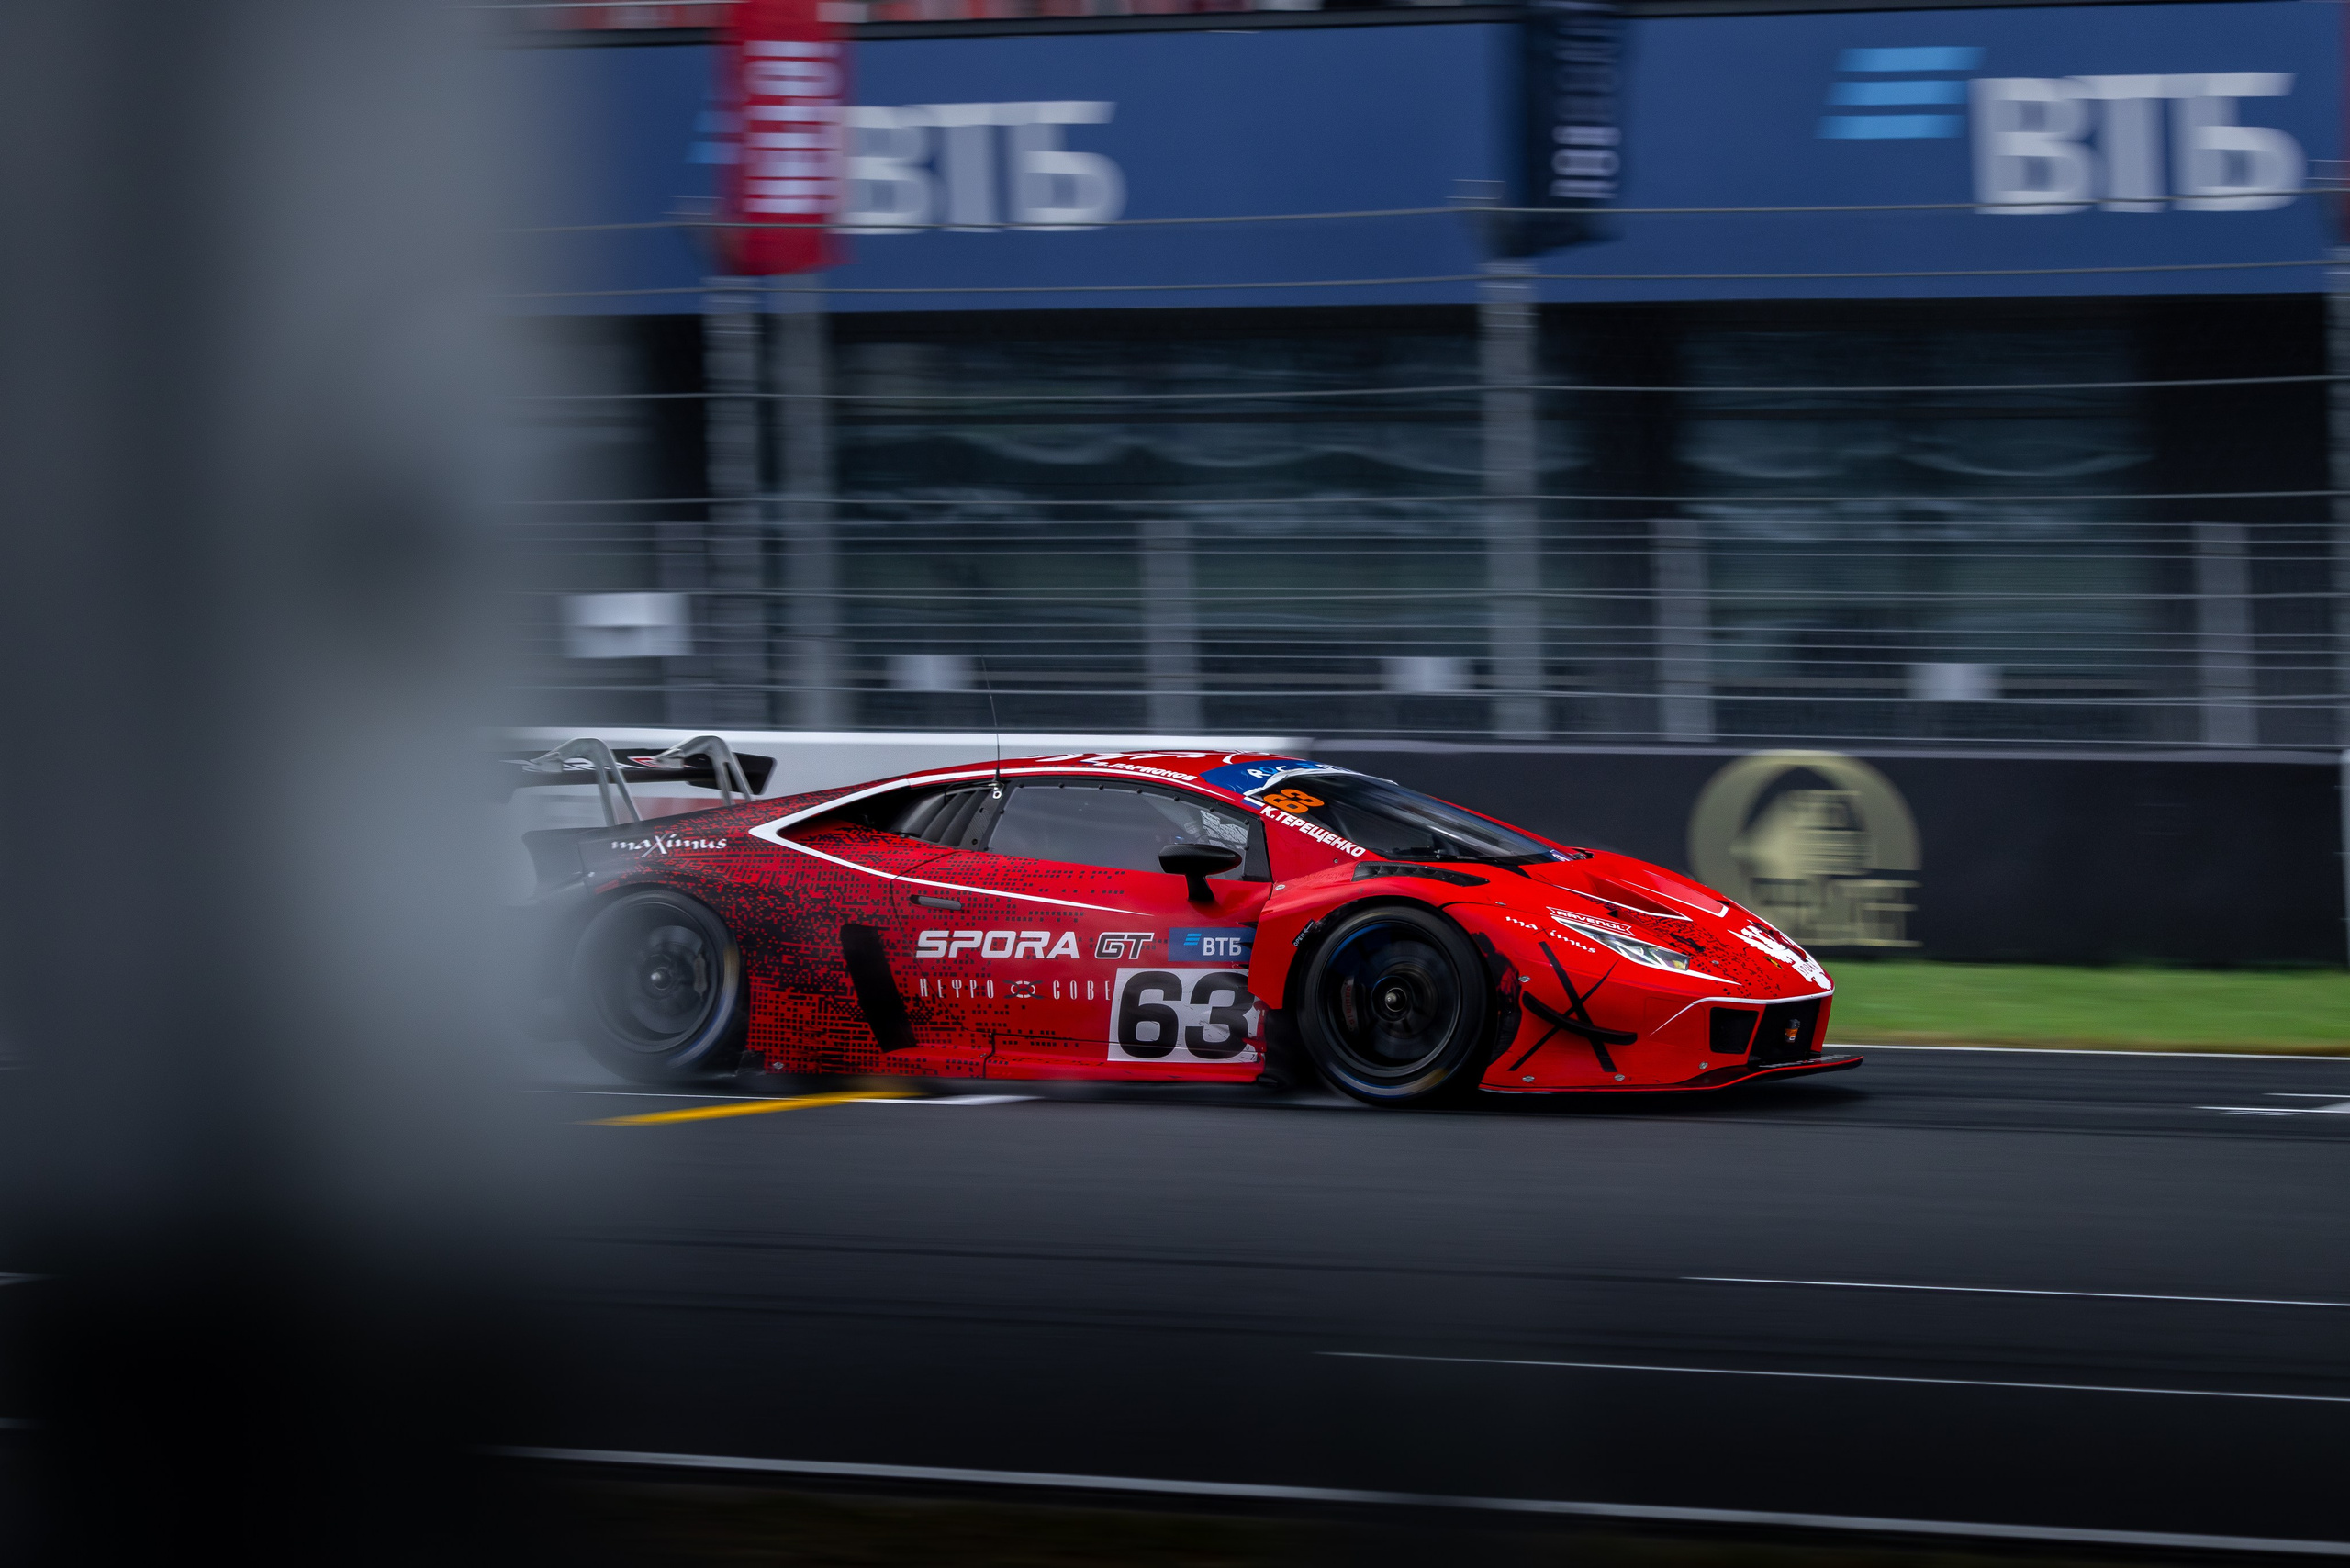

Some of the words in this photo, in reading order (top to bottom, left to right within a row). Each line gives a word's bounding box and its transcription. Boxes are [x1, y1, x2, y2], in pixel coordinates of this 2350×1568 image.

[1968, 72, 2310, 215] ВТБ
[820, 100, 1127, 235] ВТБ
[1263, 789, 1325, 814] 63
[1259, 805, 1366, 857] К.ТЕРЕЩЕНКО
[1556, 910, 1626, 932] RAVENOL
[916, 930, 1080, 959] SPORA
[1094, 932, 1155, 960] GT
[1203, 936, 1243, 957] ВТБ
[1292, 932, 1305, 947] OPEN
[919, 978, 995, 1000] НЕФРО
[1117, 970, 1258, 1059] 63
